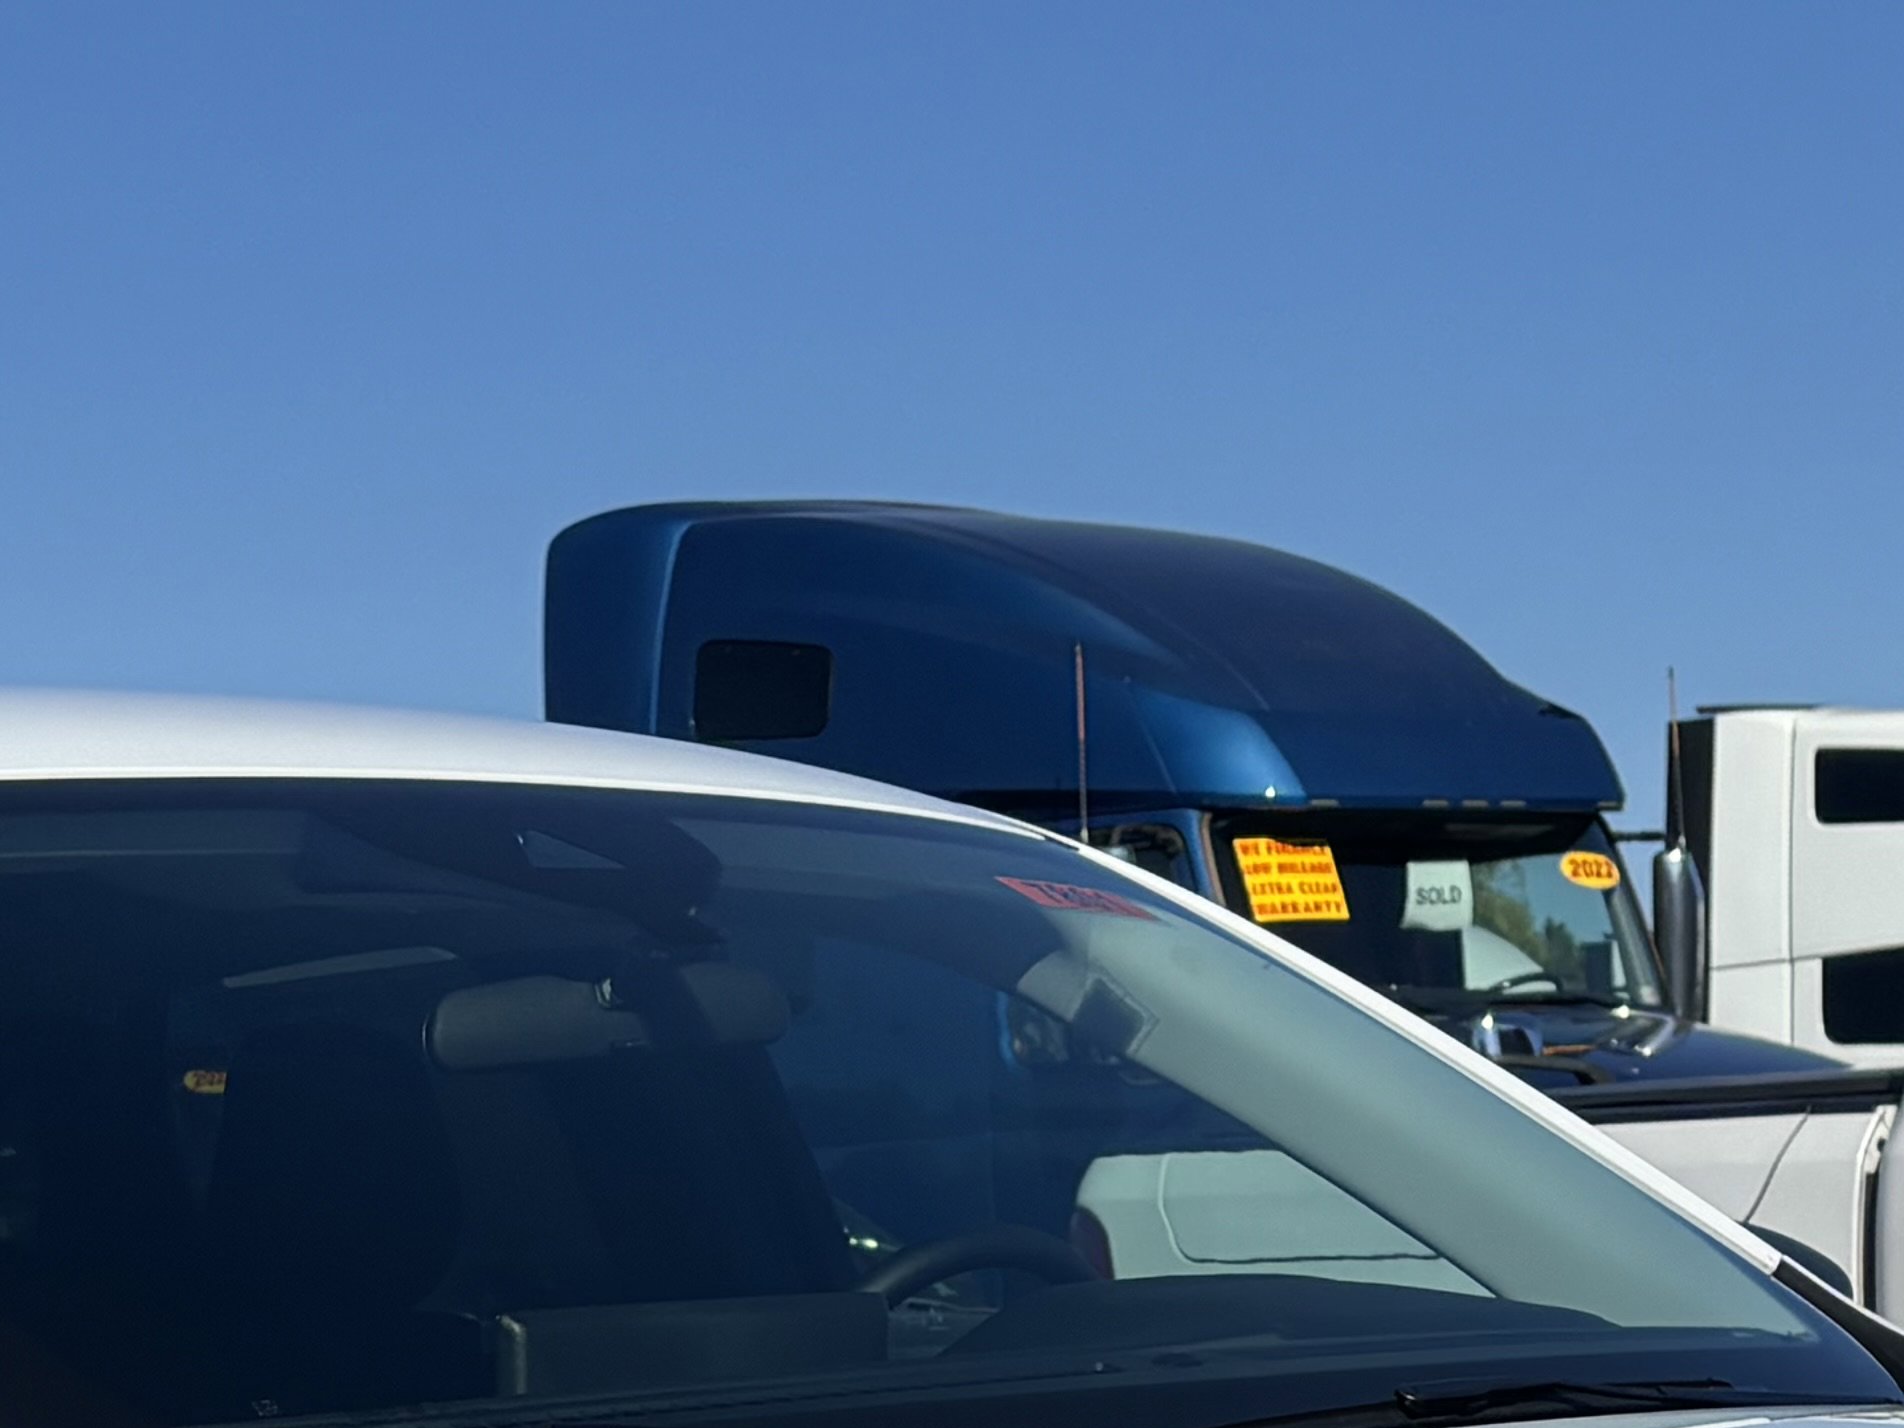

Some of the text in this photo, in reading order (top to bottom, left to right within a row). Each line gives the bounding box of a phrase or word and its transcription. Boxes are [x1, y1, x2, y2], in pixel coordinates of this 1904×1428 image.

[1245, 861, 1332, 875] LOW MILEAGE
[1252, 881, 1293, 895] EXTRA
[1415, 884, 1462, 905] SOLD
[1257, 900, 1342, 915] WARRANTY
